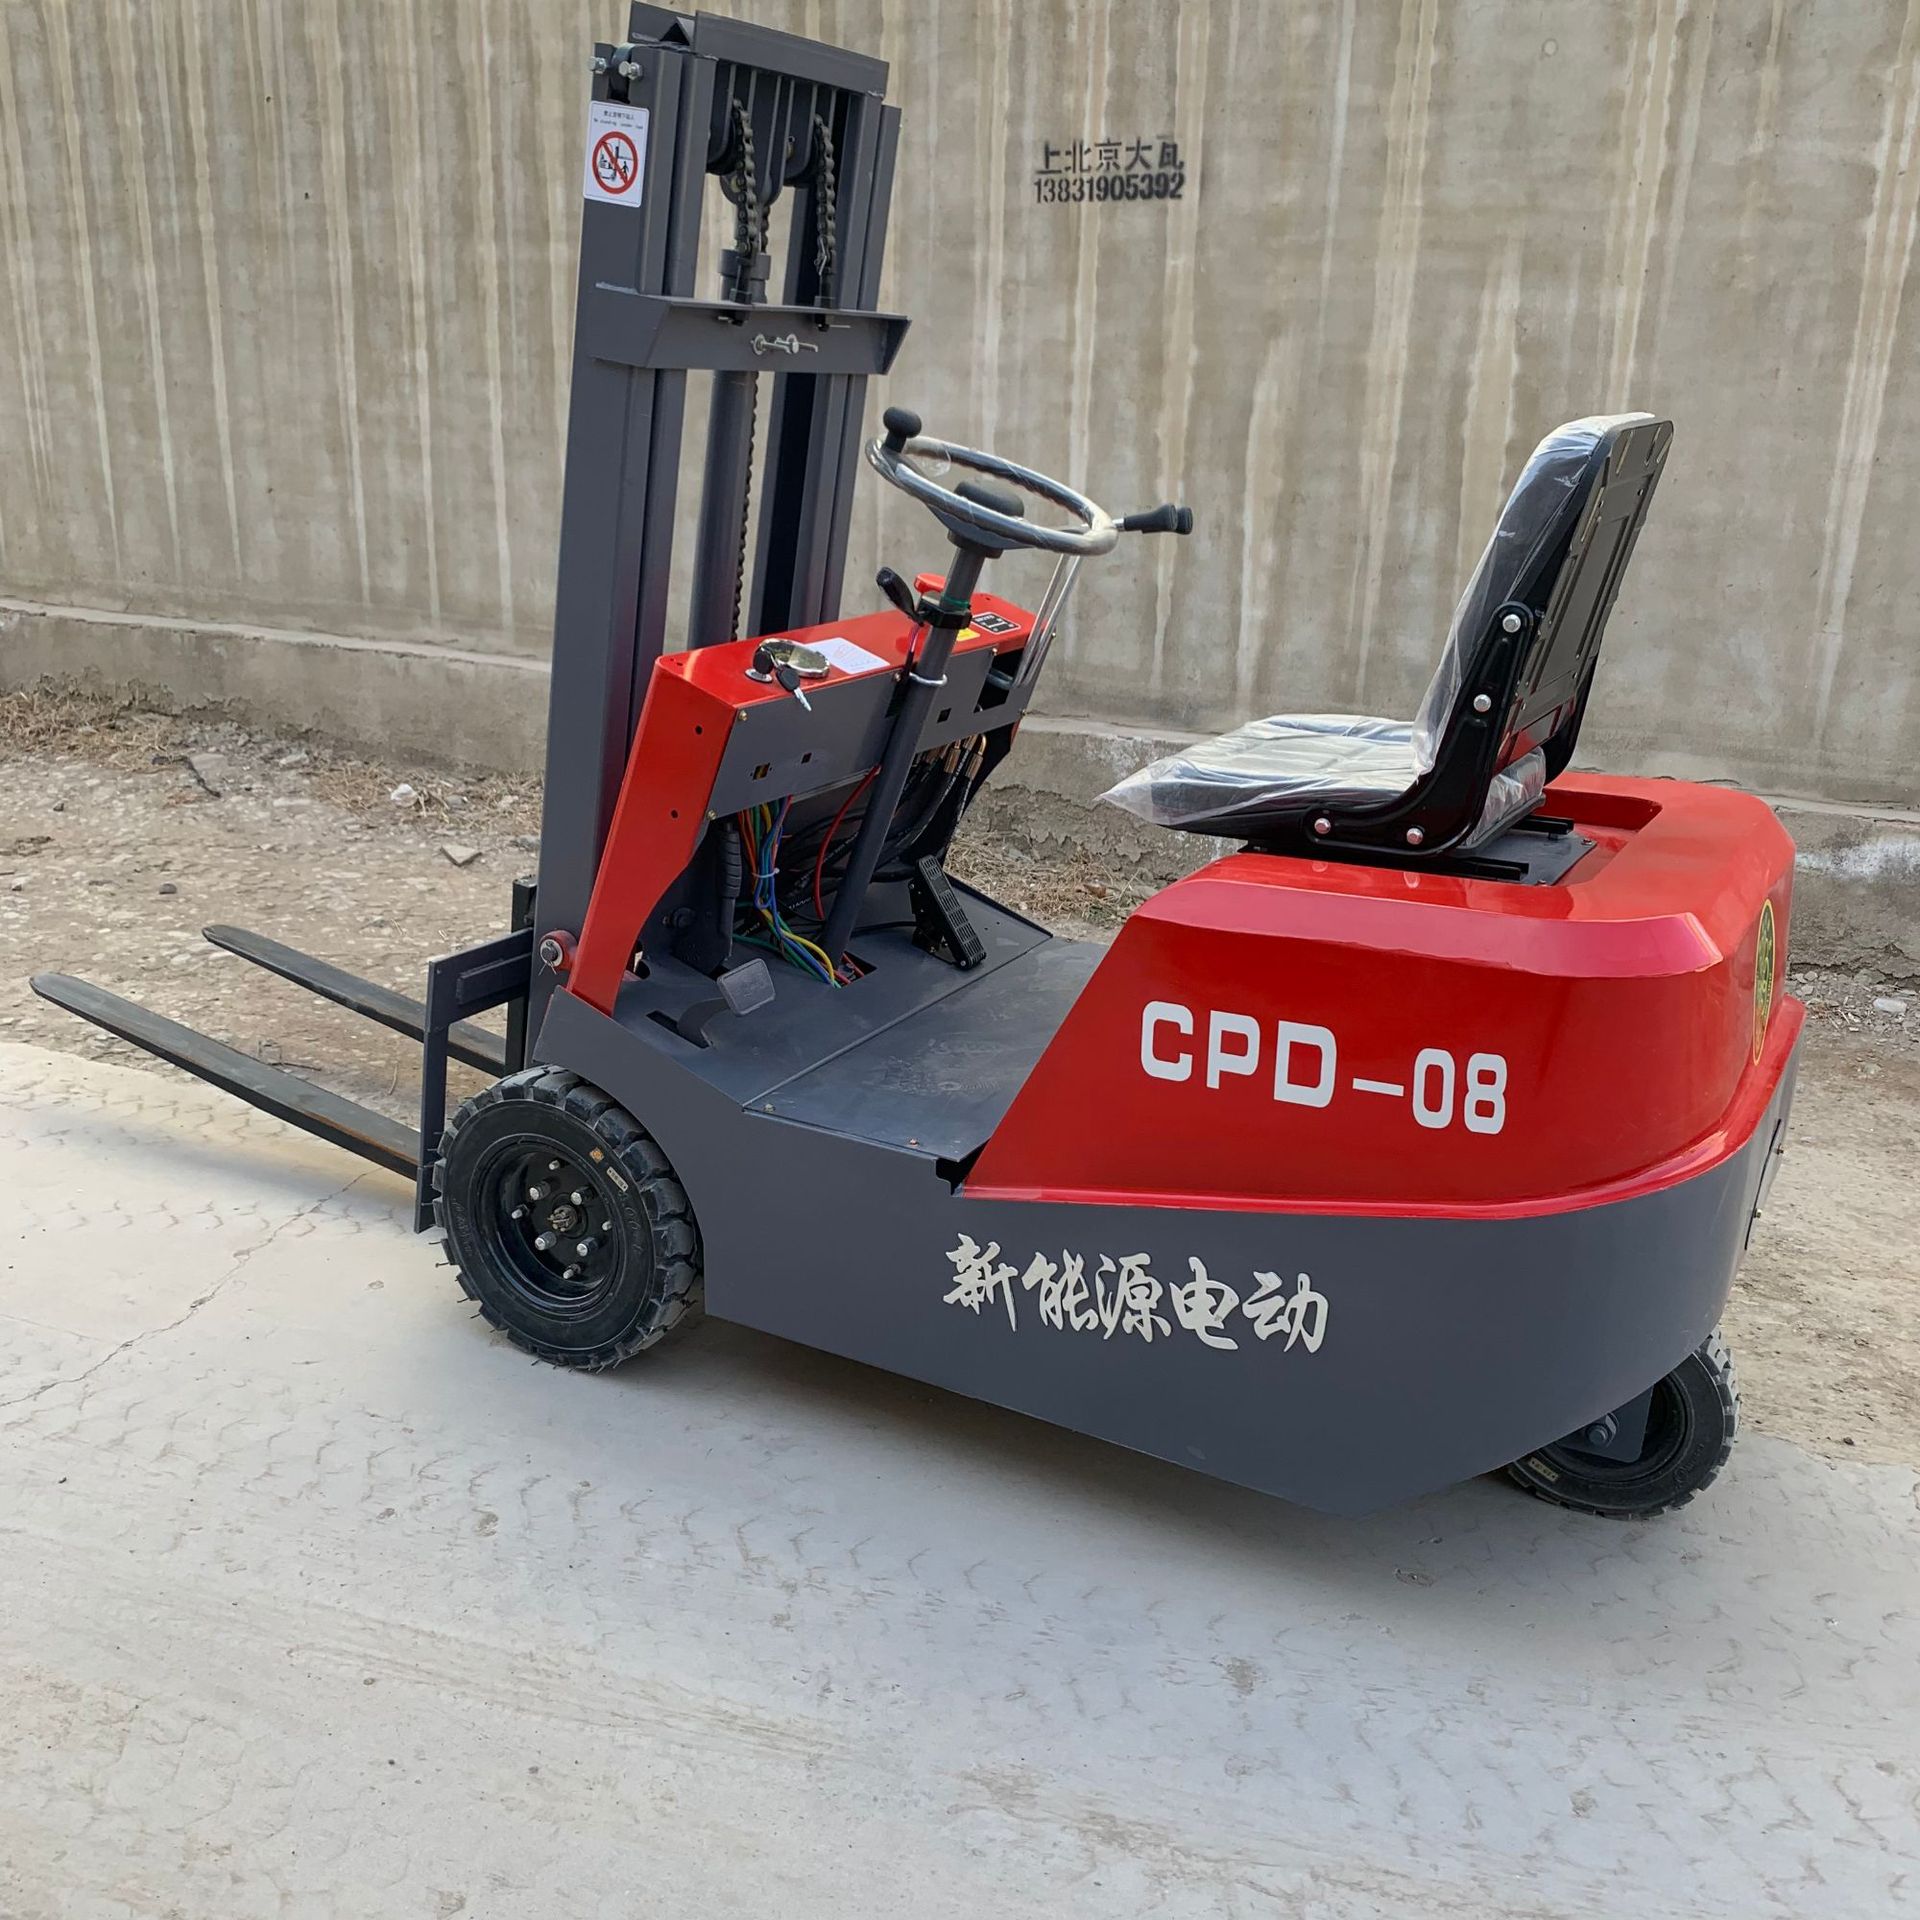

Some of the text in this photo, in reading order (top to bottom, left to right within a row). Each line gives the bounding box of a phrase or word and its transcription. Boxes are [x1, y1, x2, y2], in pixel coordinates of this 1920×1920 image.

[942, 1233, 1330, 1354] 新能源电动
